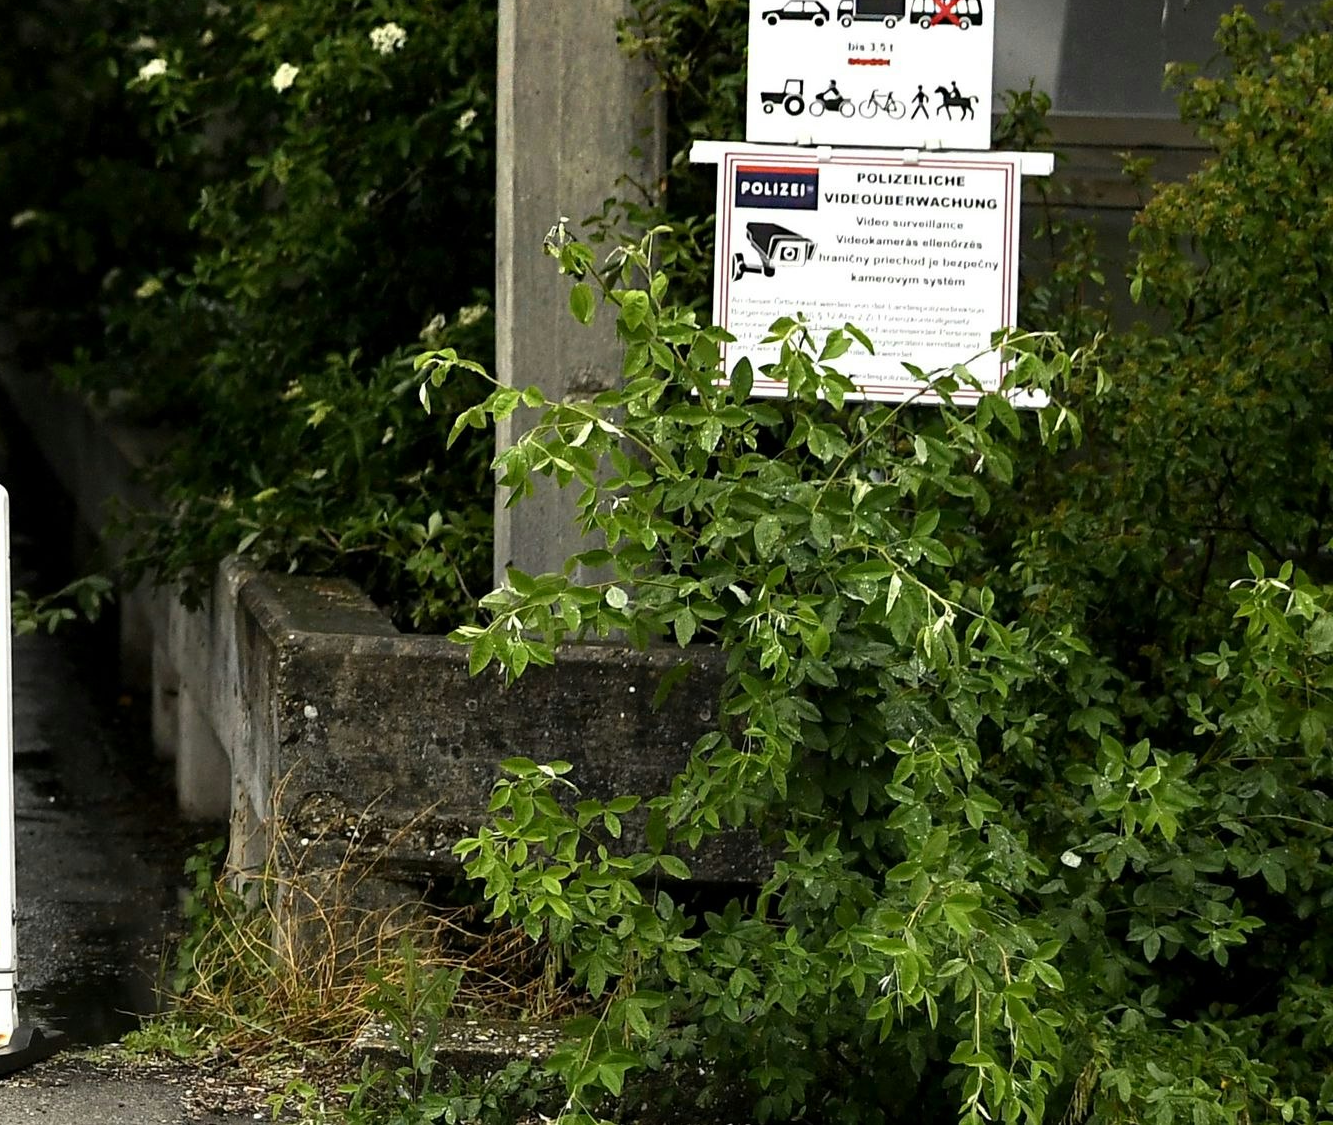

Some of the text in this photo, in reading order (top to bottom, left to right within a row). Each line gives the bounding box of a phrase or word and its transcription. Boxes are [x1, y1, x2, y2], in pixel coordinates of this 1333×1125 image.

[857, 173, 965, 187] POLIZEILICHE
[740, 181, 806, 197] POLIZEI
[824, 192, 998, 210] VIDEOÜBERWACHUNG
[856, 216, 964, 229] Video surveillance
[836, 235, 918, 247] Videokamerás
[873, 256, 926, 266] priechod
[928, 258, 939, 269] je
